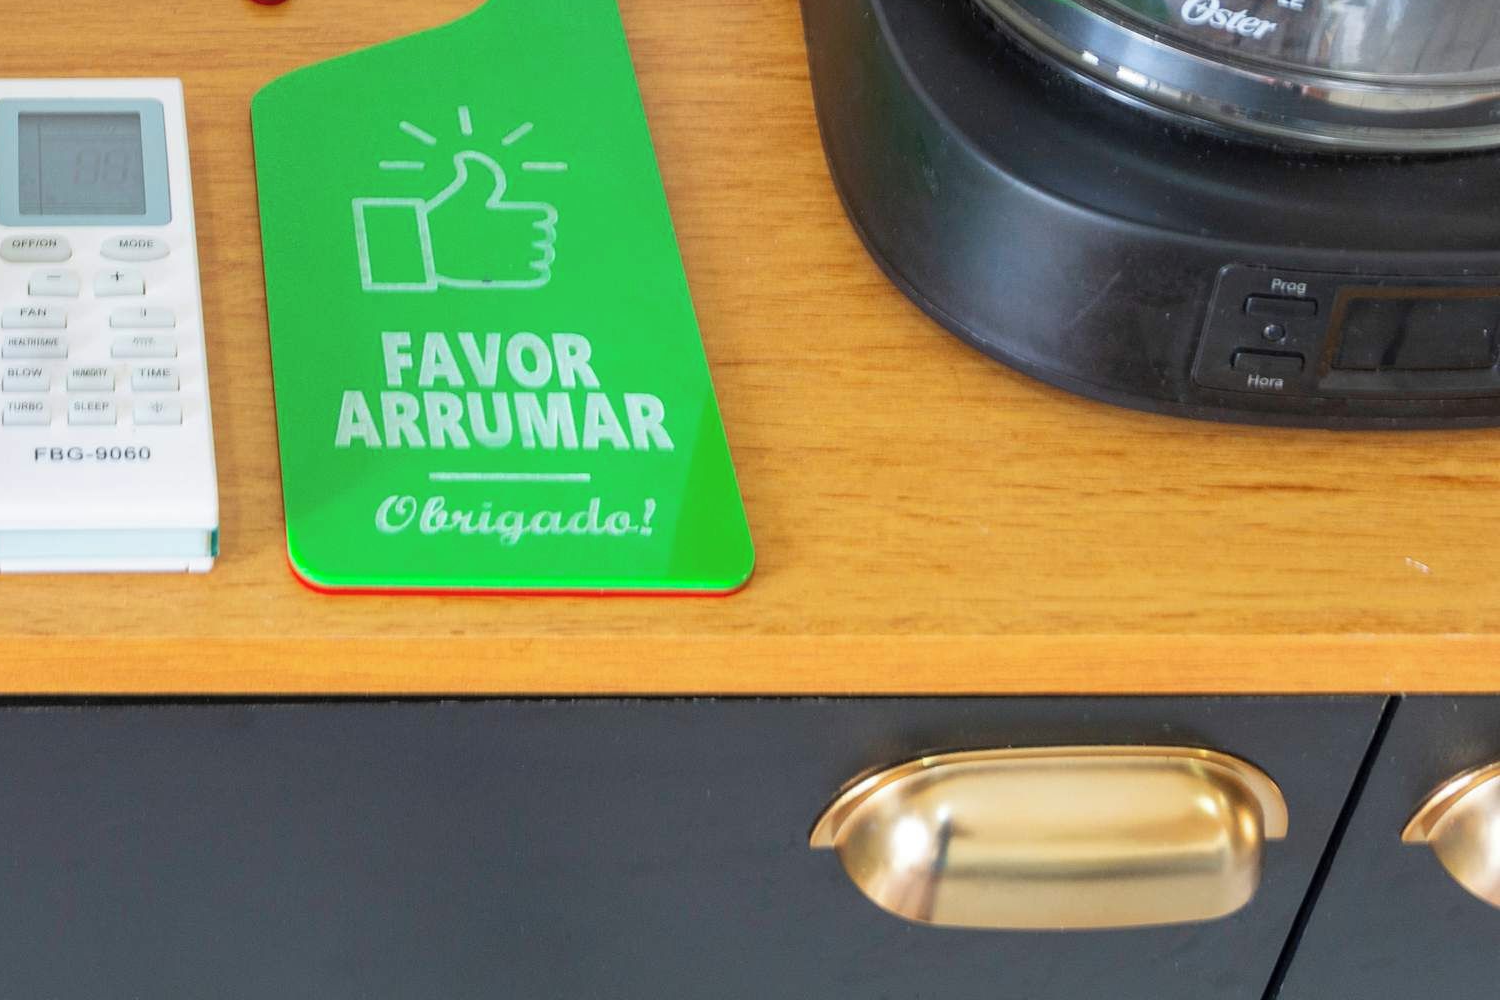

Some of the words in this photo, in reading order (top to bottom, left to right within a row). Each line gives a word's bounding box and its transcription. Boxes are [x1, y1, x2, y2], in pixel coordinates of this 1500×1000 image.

[12, 238, 58, 249] OFF/ON
[119, 239, 155, 249] MODE
[1271, 278, 1308, 295] Prog
[20, 307, 47, 318] FAN
[380, 331, 601, 389] FAVOR
[7, 367, 43, 378] BLOW
[1248, 374, 1284, 390] Hora
[8, 401, 43, 412] TURBO
[73, 401, 110, 412] SLEEP
[334, 389, 675, 451] ARRUMAR
[34, 446, 151, 462] FBG-9060
[375, 494, 657, 546] Obrigado!
